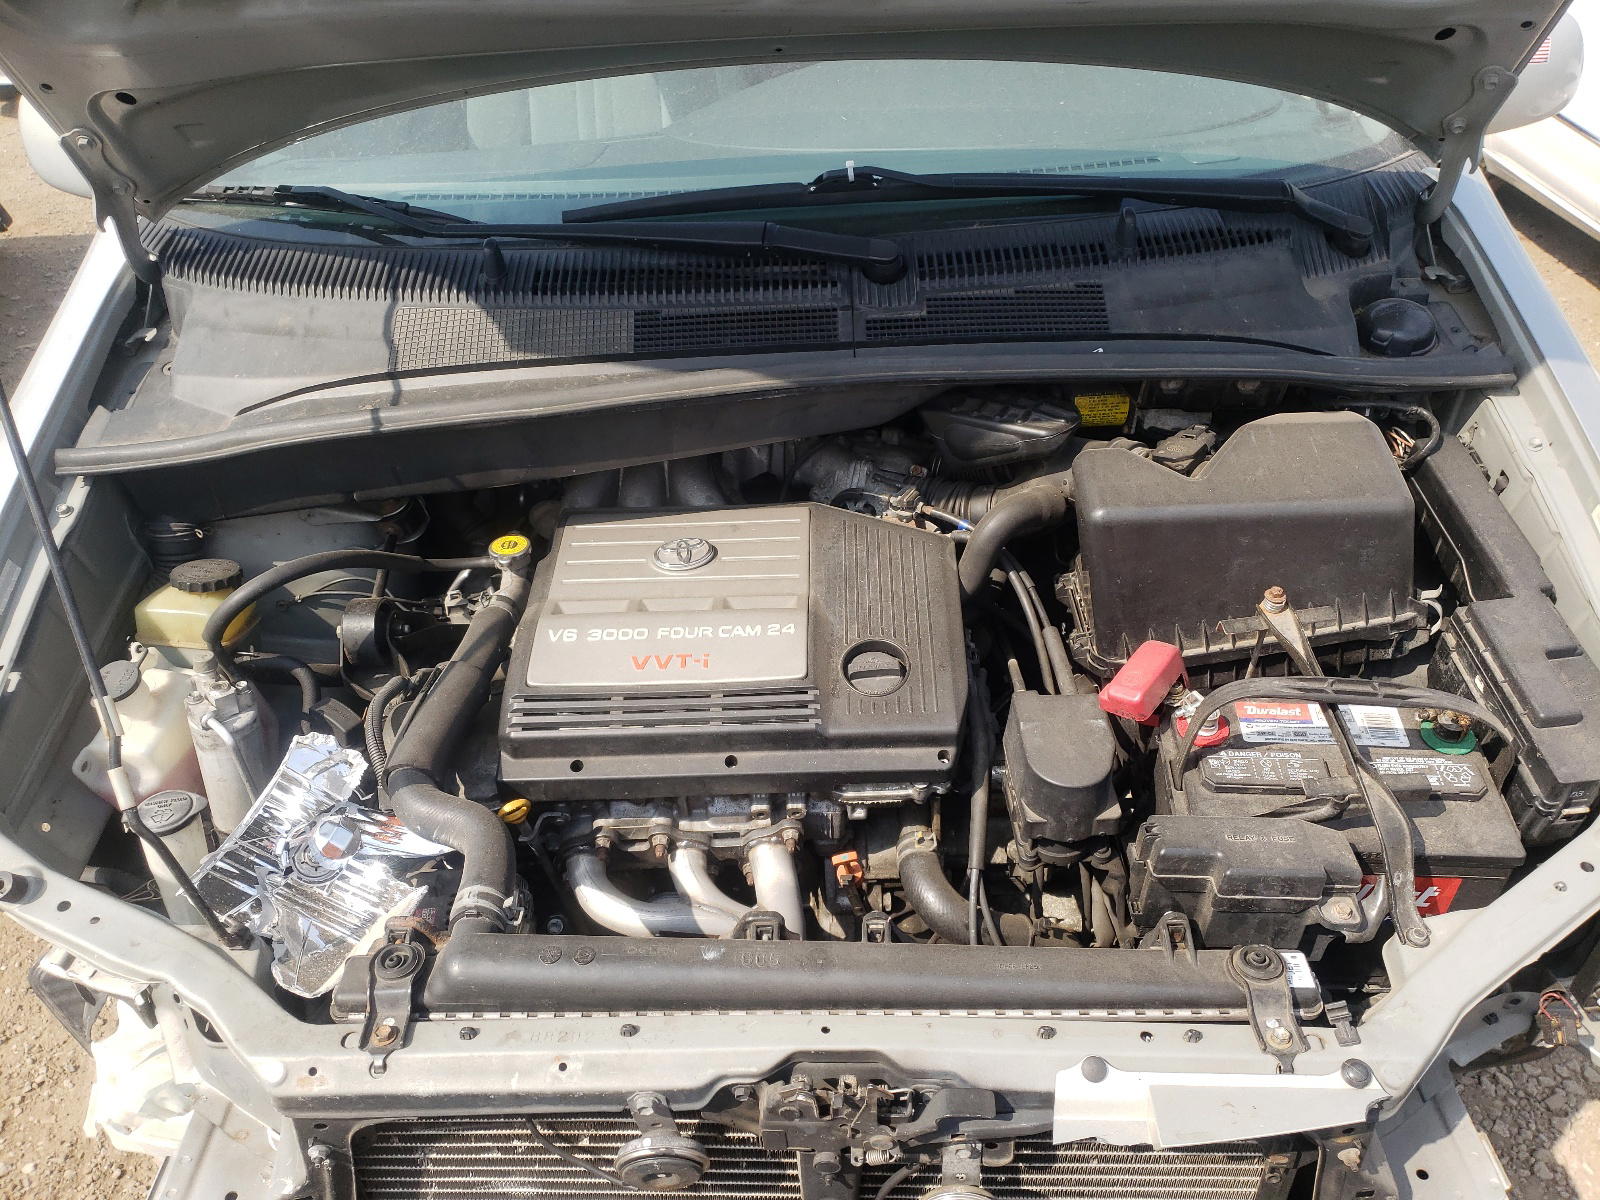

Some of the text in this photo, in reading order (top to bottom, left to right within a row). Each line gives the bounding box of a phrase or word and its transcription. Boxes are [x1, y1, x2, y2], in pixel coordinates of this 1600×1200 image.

[548, 623, 796, 642] V6 3000 FOUR CAM 24
[631, 653, 710, 671] VVT-i
[1244, 705, 1302, 717] Duralast
[1228, 750, 1263, 758] DANGER
